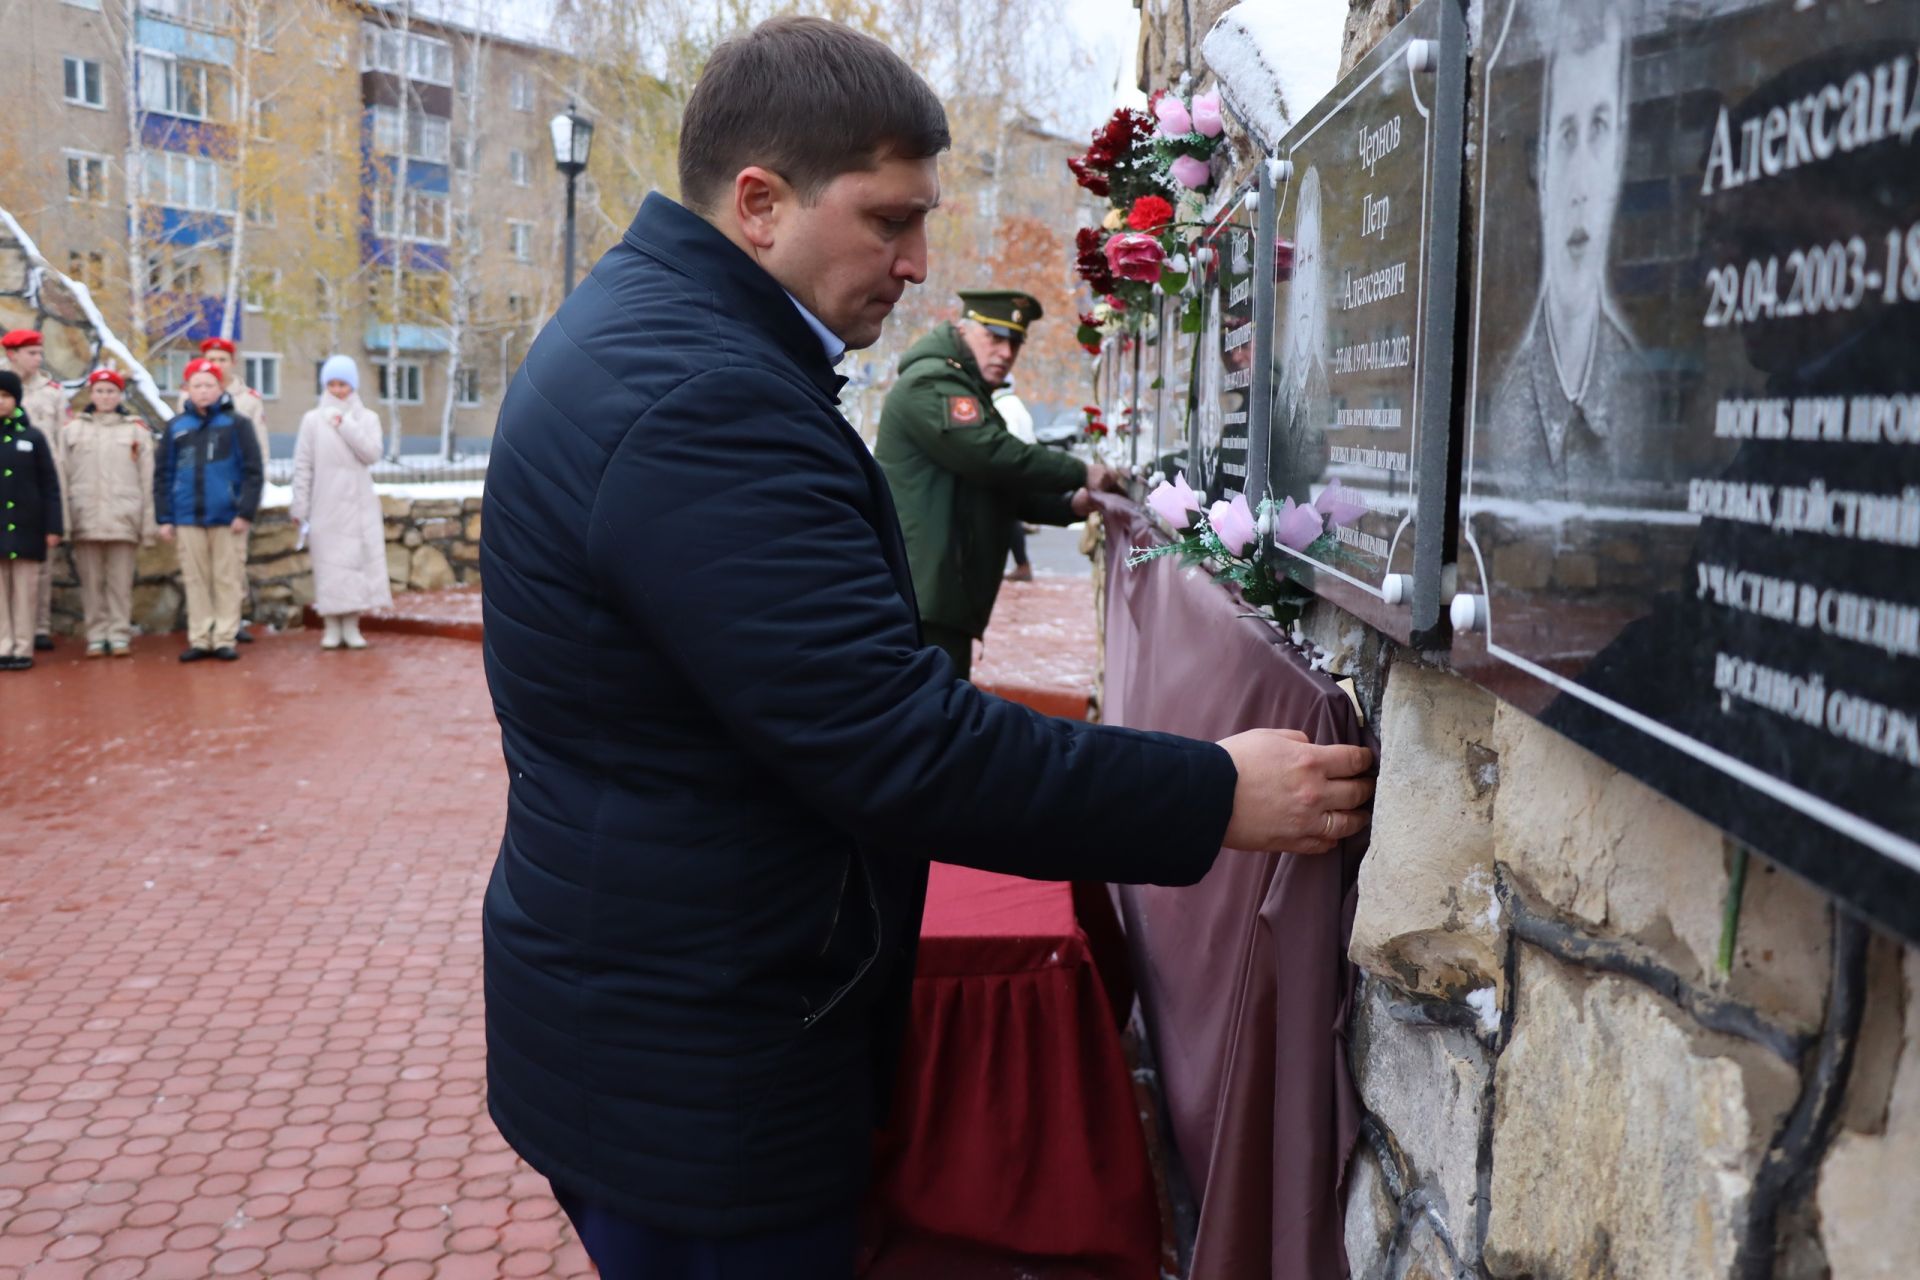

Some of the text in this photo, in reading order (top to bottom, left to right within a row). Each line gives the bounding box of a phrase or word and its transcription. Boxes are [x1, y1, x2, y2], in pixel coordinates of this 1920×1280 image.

[1359, 115, 1401, 178] Чернов
[1361, 193, 1390, 241] Петр
[1343, 262, 1407, 311] Алексеевич
[1703, 220, 1920, 328] 29.04.2003-18
[1353, 409, 1364, 426] ПРИ
[1714, 396, 1790, 439] ПОГИБ
[1791, 395, 1846, 441] ПРИ
[1377, 450, 1386, 469] ВО
[1689, 478, 1920, 548] БОЕВЫХ ДЕЙСТВИЙ
[1696, 562, 1796, 624] УЧАСТИЯ
[1796, 583, 1818, 628] В
[1713, 651, 1920, 768] ВОЕННОЙ ОПЕРА
